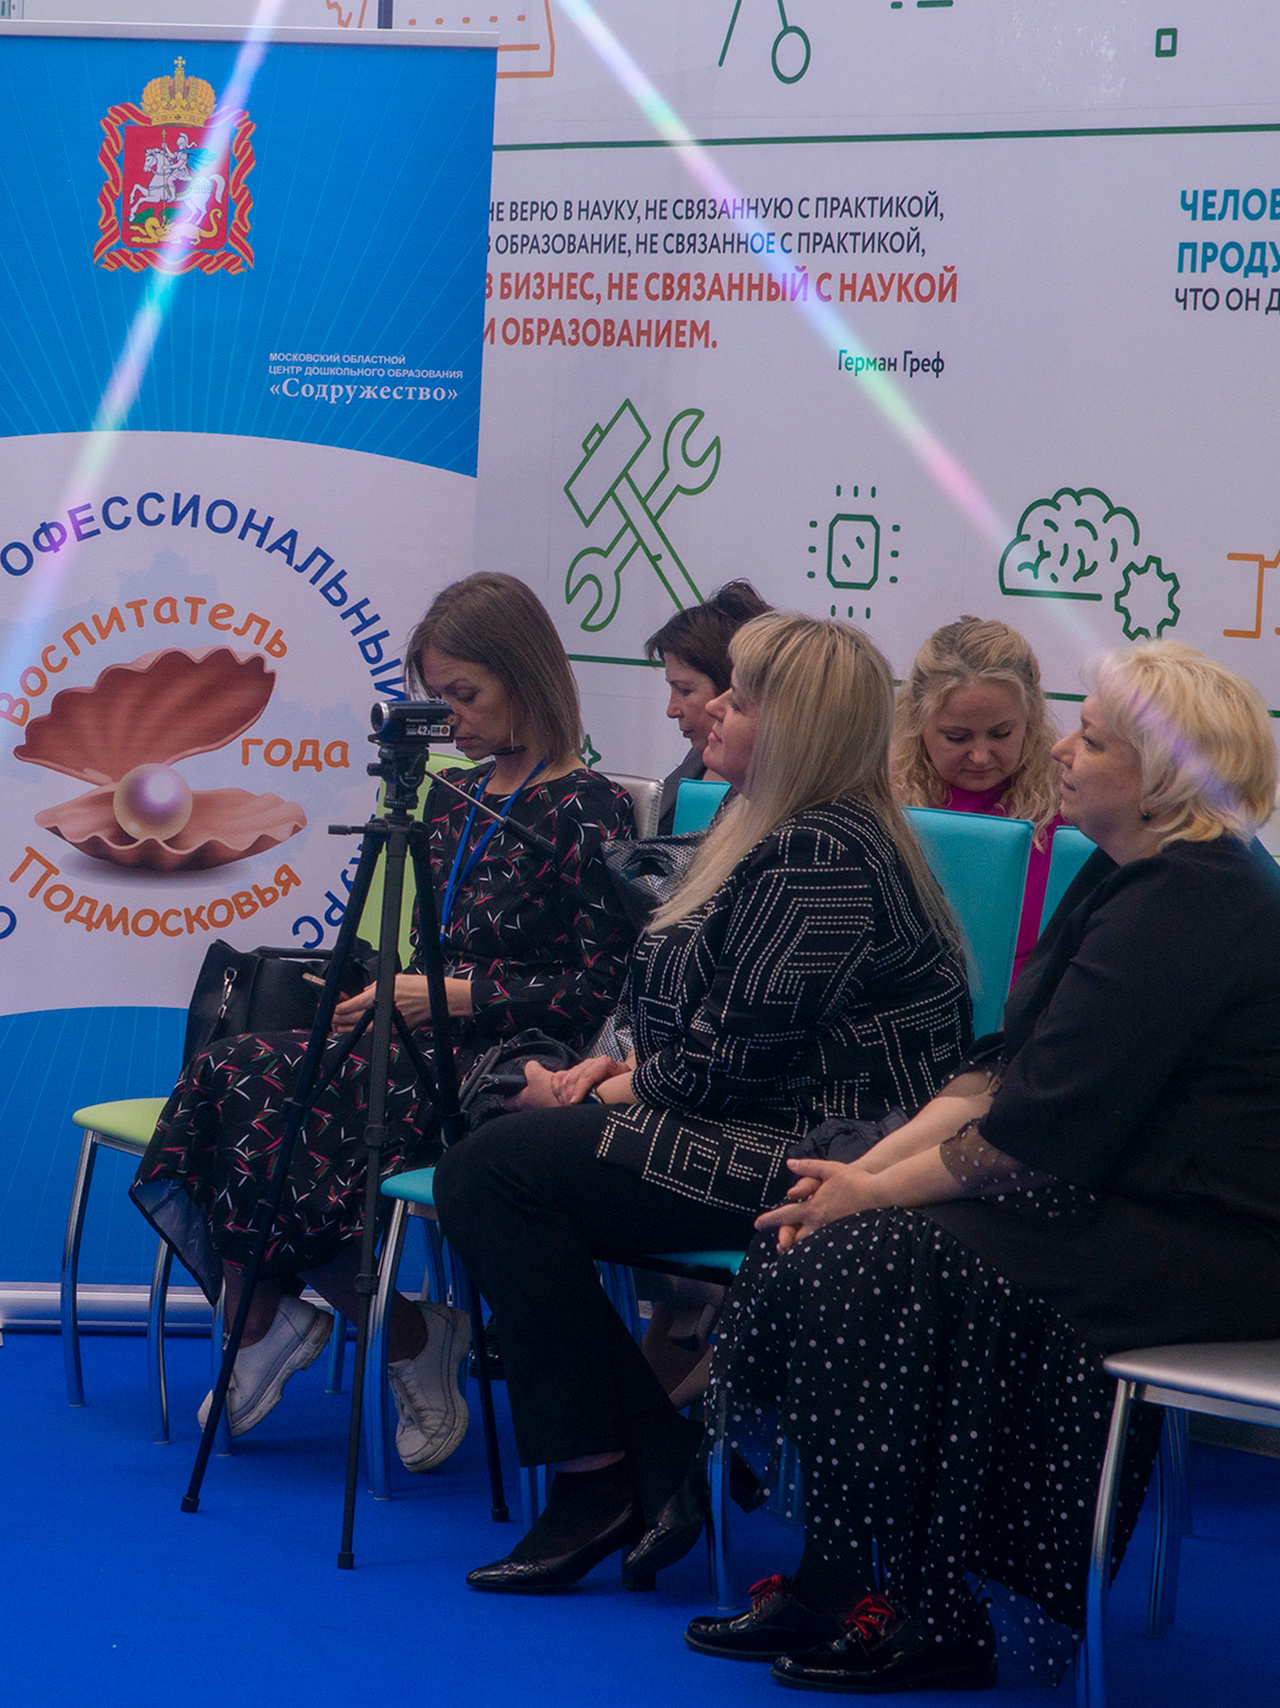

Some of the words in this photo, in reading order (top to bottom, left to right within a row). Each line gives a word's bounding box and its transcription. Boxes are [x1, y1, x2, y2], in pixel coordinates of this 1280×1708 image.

[509, 200, 558, 221] ВЕРЮ
[564, 200, 573, 221] В
[578, 199, 641, 224] НАУКУ,
[645, 199, 668, 221] НЕ
[673, 197, 794, 221] СВЯЗАННУЮ
[798, 197, 811, 219] С
[815, 190, 945, 222] ПРАКТИКОЙ,
[1180, 188, 1280, 221] ЧЕЛОВ
[495, 233, 632, 257] ОБРАЗОВАНИЕ,
[635, 233, 659, 254] НЕ
[663, 232, 776, 254] СВЯЗАННОЕ
[780, 232, 793, 254] С
[798, 226, 926, 257] ПРАКТИКОЙ,
[500, 272, 602, 305] БИЗНЕС,
[607, 272, 639, 301] НЕ
[644, 265, 809, 302] СВЯЗАННЫЙ
[816, 272, 833, 302] С
[838, 265, 958, 303] НАУКОЙ
[1175, 287, 1220, 311] ЧТО
[1225, 287, 1261, 311] ОН
[501, 317, 718, 349] ОБРАЗОВАНИЕМ.
[269, 352, 340, 363] МОСКОВСКИЙ
[342, 353, 406, 365] ОБЛАСТНОЙ
[269, 365, 303, 376] ЦЕНТР
[304, 366, 386, 377] ДОШКОЛЬНОГО
[387, 368, 463, 379] ОБРАЗОВАНИЯ
[838, 349, 897, 377] Герман
[902, 351, 945, 378] Греф
[270, 377, 458, 404] «Содружество»
[241, 738, 350, 772] года
[9, 846, 302, 938] Подмосковья
